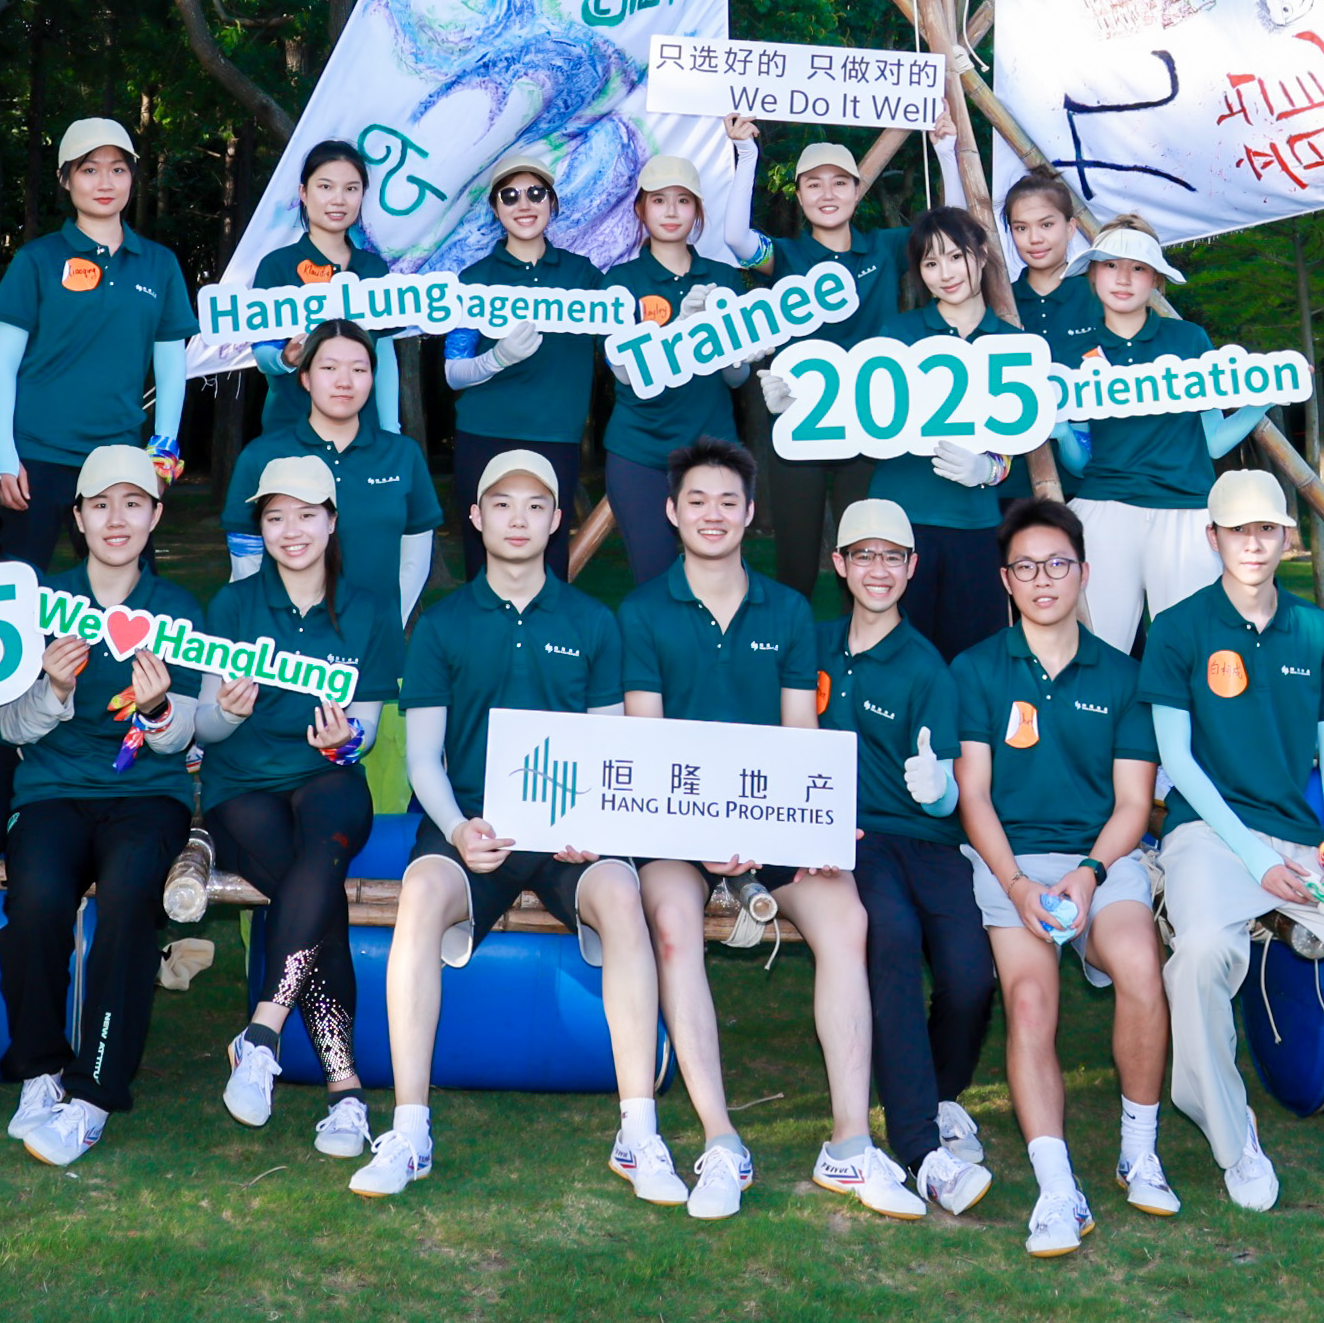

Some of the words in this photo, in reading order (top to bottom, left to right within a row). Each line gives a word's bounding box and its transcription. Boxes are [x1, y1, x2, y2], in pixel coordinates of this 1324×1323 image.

[656, 42, 788, 79] 只选好的
[807, 53, 938, 89] 只做对的
[730, 85, 778, 114] We
[789, 89, 830, 117] Do
[842, 93, 860, 119] It
[872, 95, 937, 124] Well
[209, 294, 329, 333] Hang
[342, 282, 452, 323] Lung
[457, 295, 625, 328] agement
[616, 272, 849, 389] Trainee
[789, 352, 1039, 442] 2025
[39, 593, 101, 641] We
[153, 619, 353, 703] HangLung
[602, 759, 834, 803] 恒隆地产
[601, 793, 659, 814] HANG
[667, 797, 720, 818] LUNG
[726, 801, 835, 826] PROPERTIES
[101, 1012, 111, 1039] NEW
[93, 1041, 105, 1085] ATTITU
